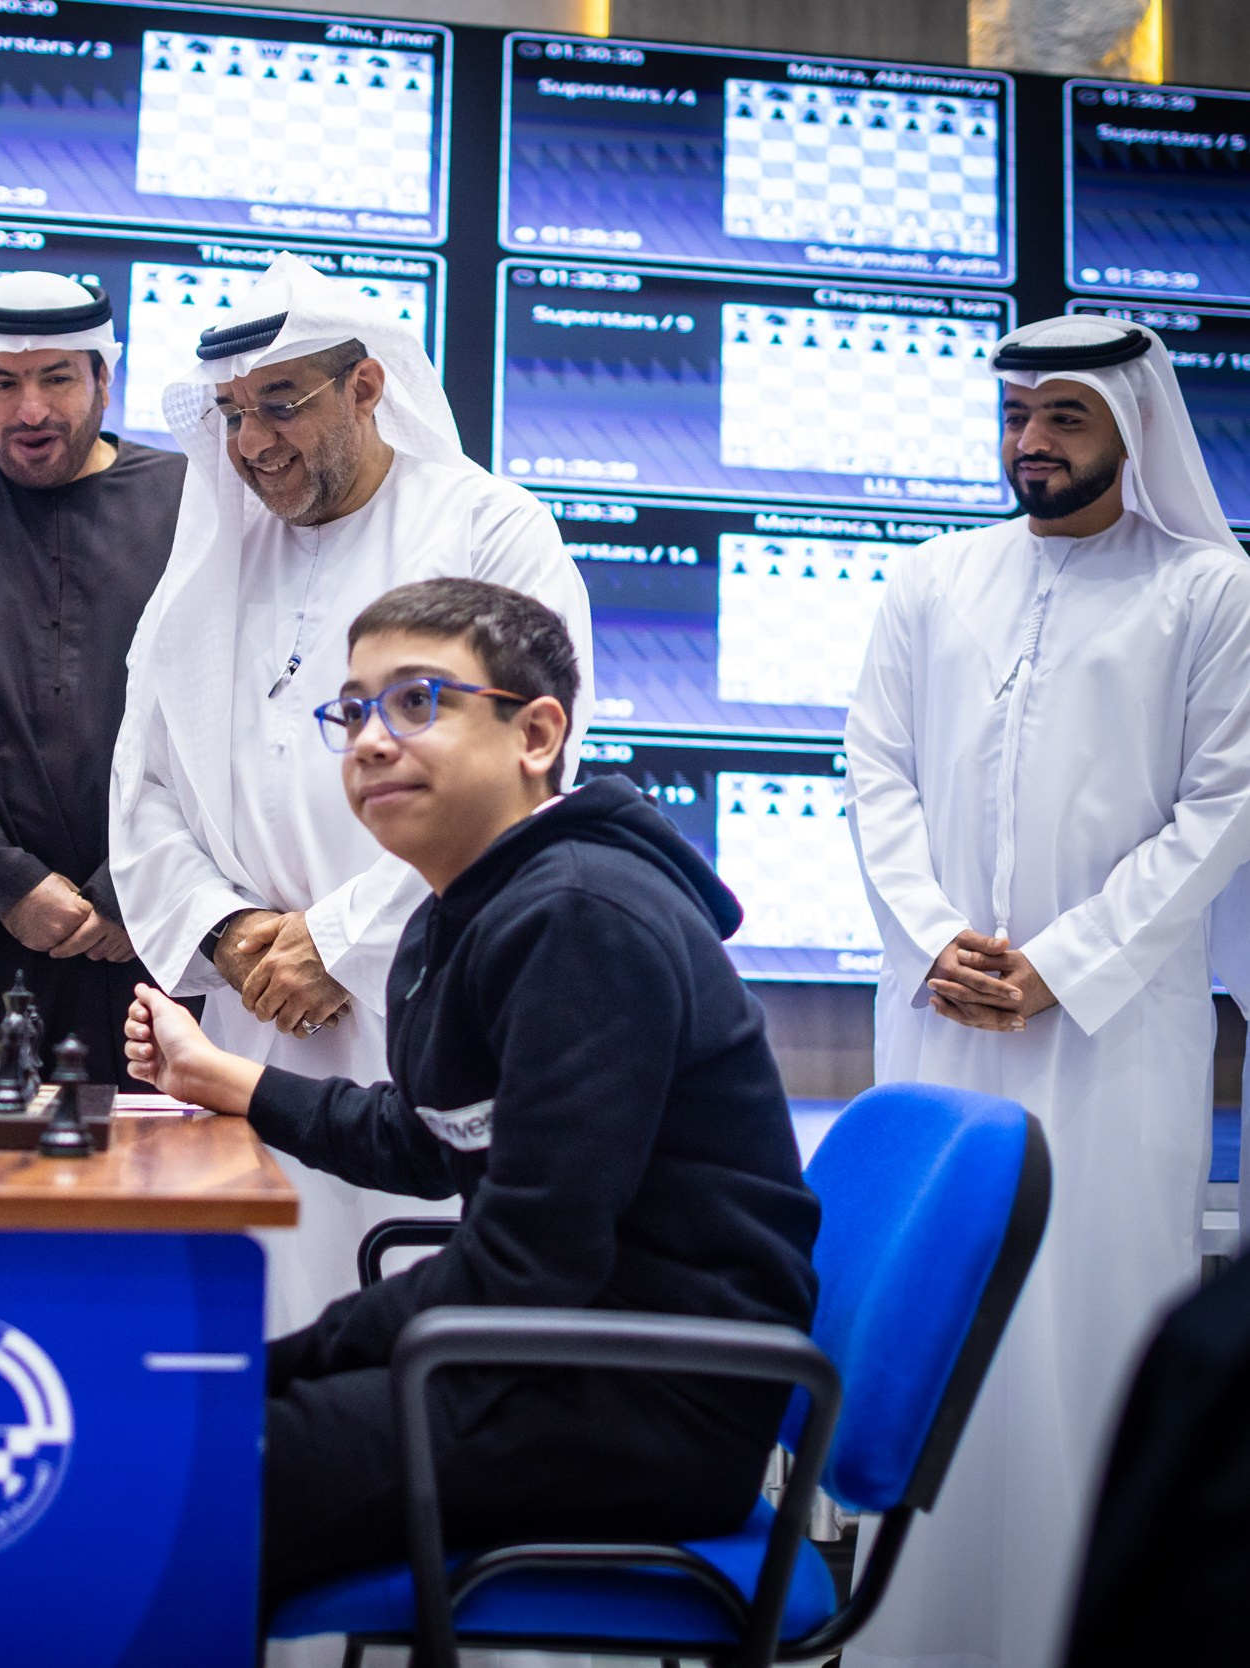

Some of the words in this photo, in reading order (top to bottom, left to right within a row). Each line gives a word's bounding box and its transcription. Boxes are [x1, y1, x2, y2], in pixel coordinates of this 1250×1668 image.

[325, 23, 378, 45] Zhu,
[93, 41, 113, 59] 3
[545, 42, 645, 66] 01:30:30
[538, 78, 662, 105] Superstars
[679, 89, 697, 107] 4
[1102, 89, 1196, 112] 01:30:30
[1096, 123, 1213, 150] Superstars
[540, 225, 642, 250] 01:30:30
[539, 268, 641, 292] 01:30:30
[1104, 267, 1199, 290] 01:30:30
[532, 304, 658, 331] Superstars
[534, 456, 638, 481] 01:30:30
[667, 545, 699, 566] 14
